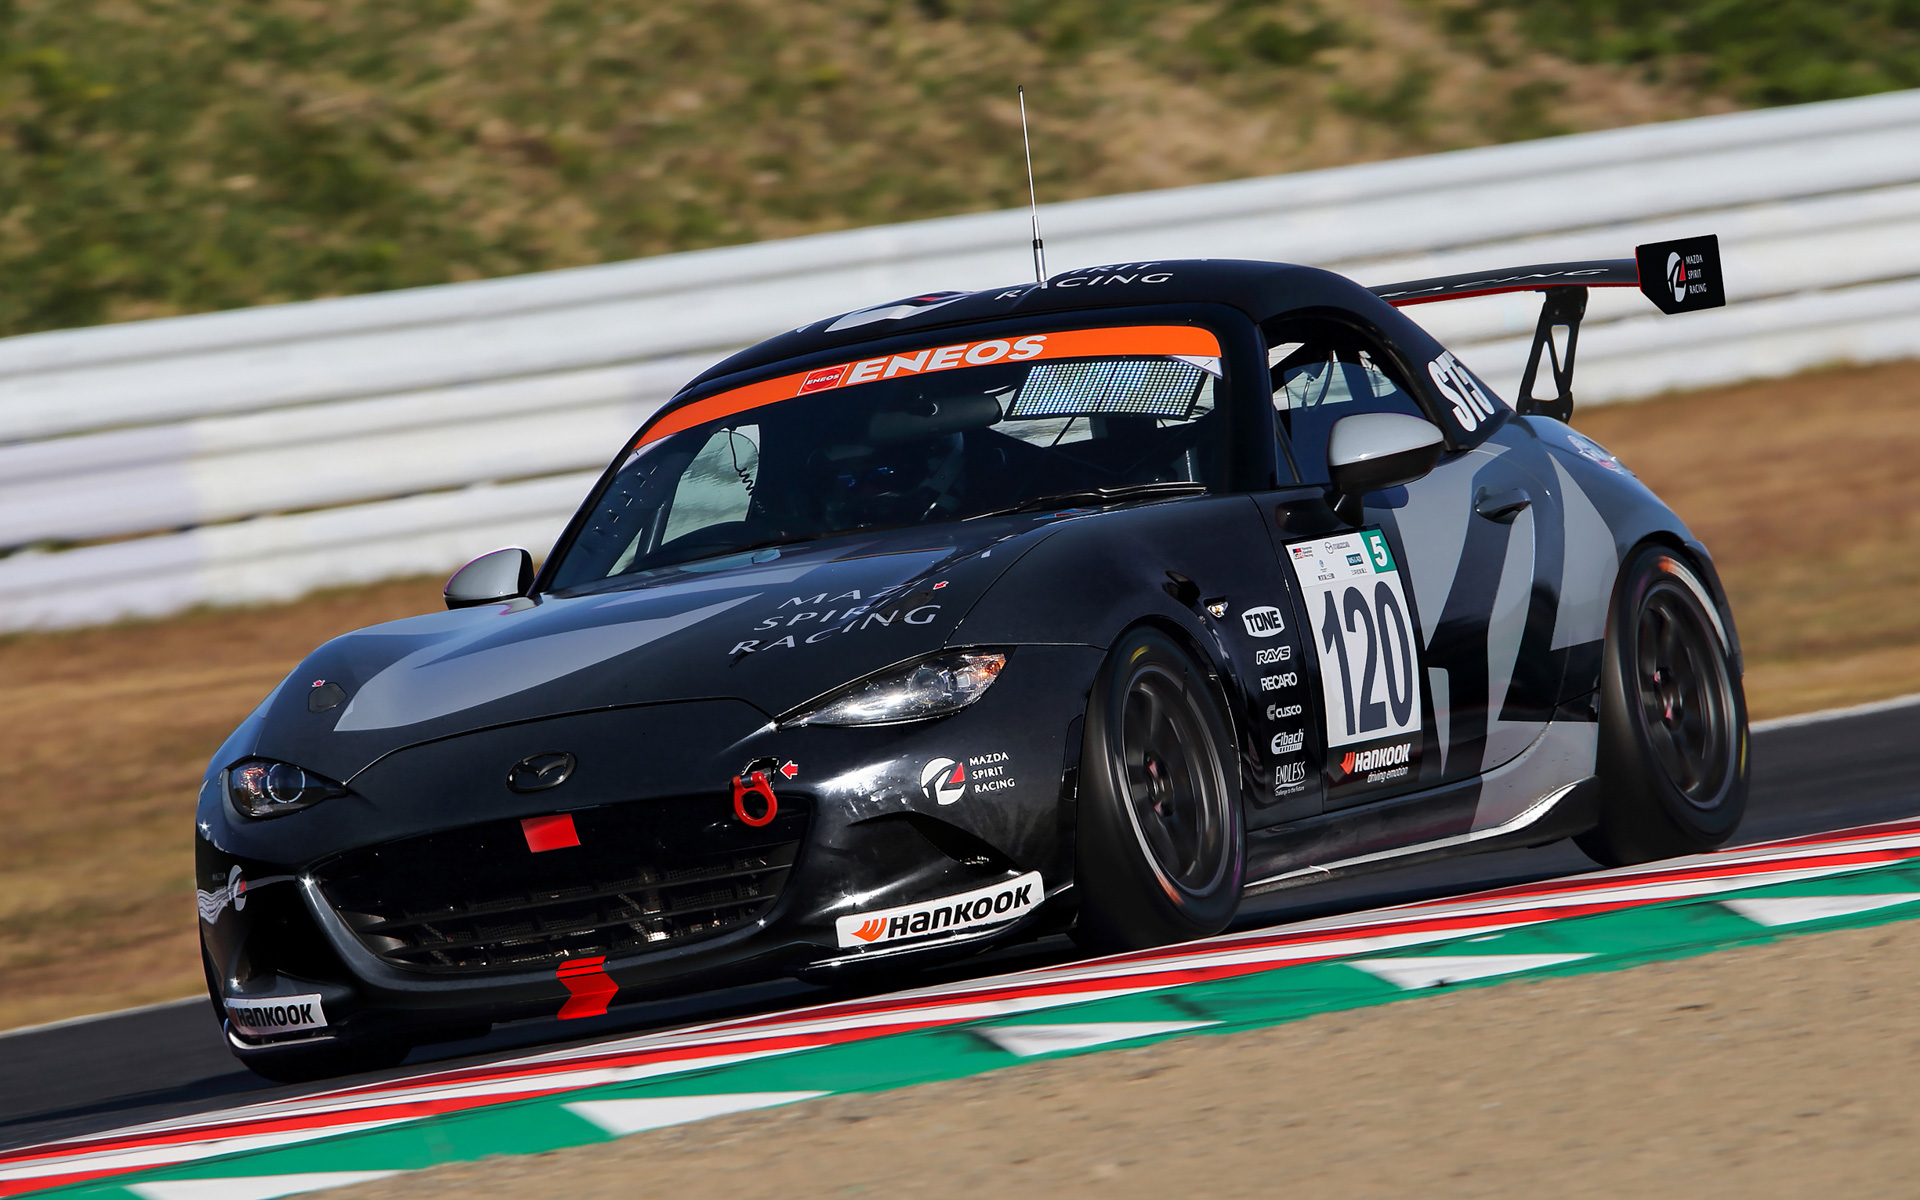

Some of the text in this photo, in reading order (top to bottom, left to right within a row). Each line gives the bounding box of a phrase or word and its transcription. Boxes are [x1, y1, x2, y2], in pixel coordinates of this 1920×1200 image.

[1686, 254, 1703, 265] MAZDA
[1688, 269, 1701, 280] SPIRIT
[1689, 283, 1707, 295] RACING
[846, 335, 1047, 385] ENEOS
[806, 373, 840, 385] ENEOS
[1370, 536, 1388, 567] 5
[728, 605, 941, 655] RACING
[1245, 610, 1282, 633] TONE
[1256, 645, 1291, 666] RAYS
[1322, 581, 1413, 736] 120
[1260, 672, 1298, 691] RECARO
[1276, 704, 1302, 719] CUSCO
[1271, 729, 1304, 753] Eibach
[969, 752, 1009, 767] MAZDA
[972, 766, 1004, 780] SPIRIT
[1275, 761, 1306, 785] ENDLESS
[974, 778, 1016, 793] RACING
